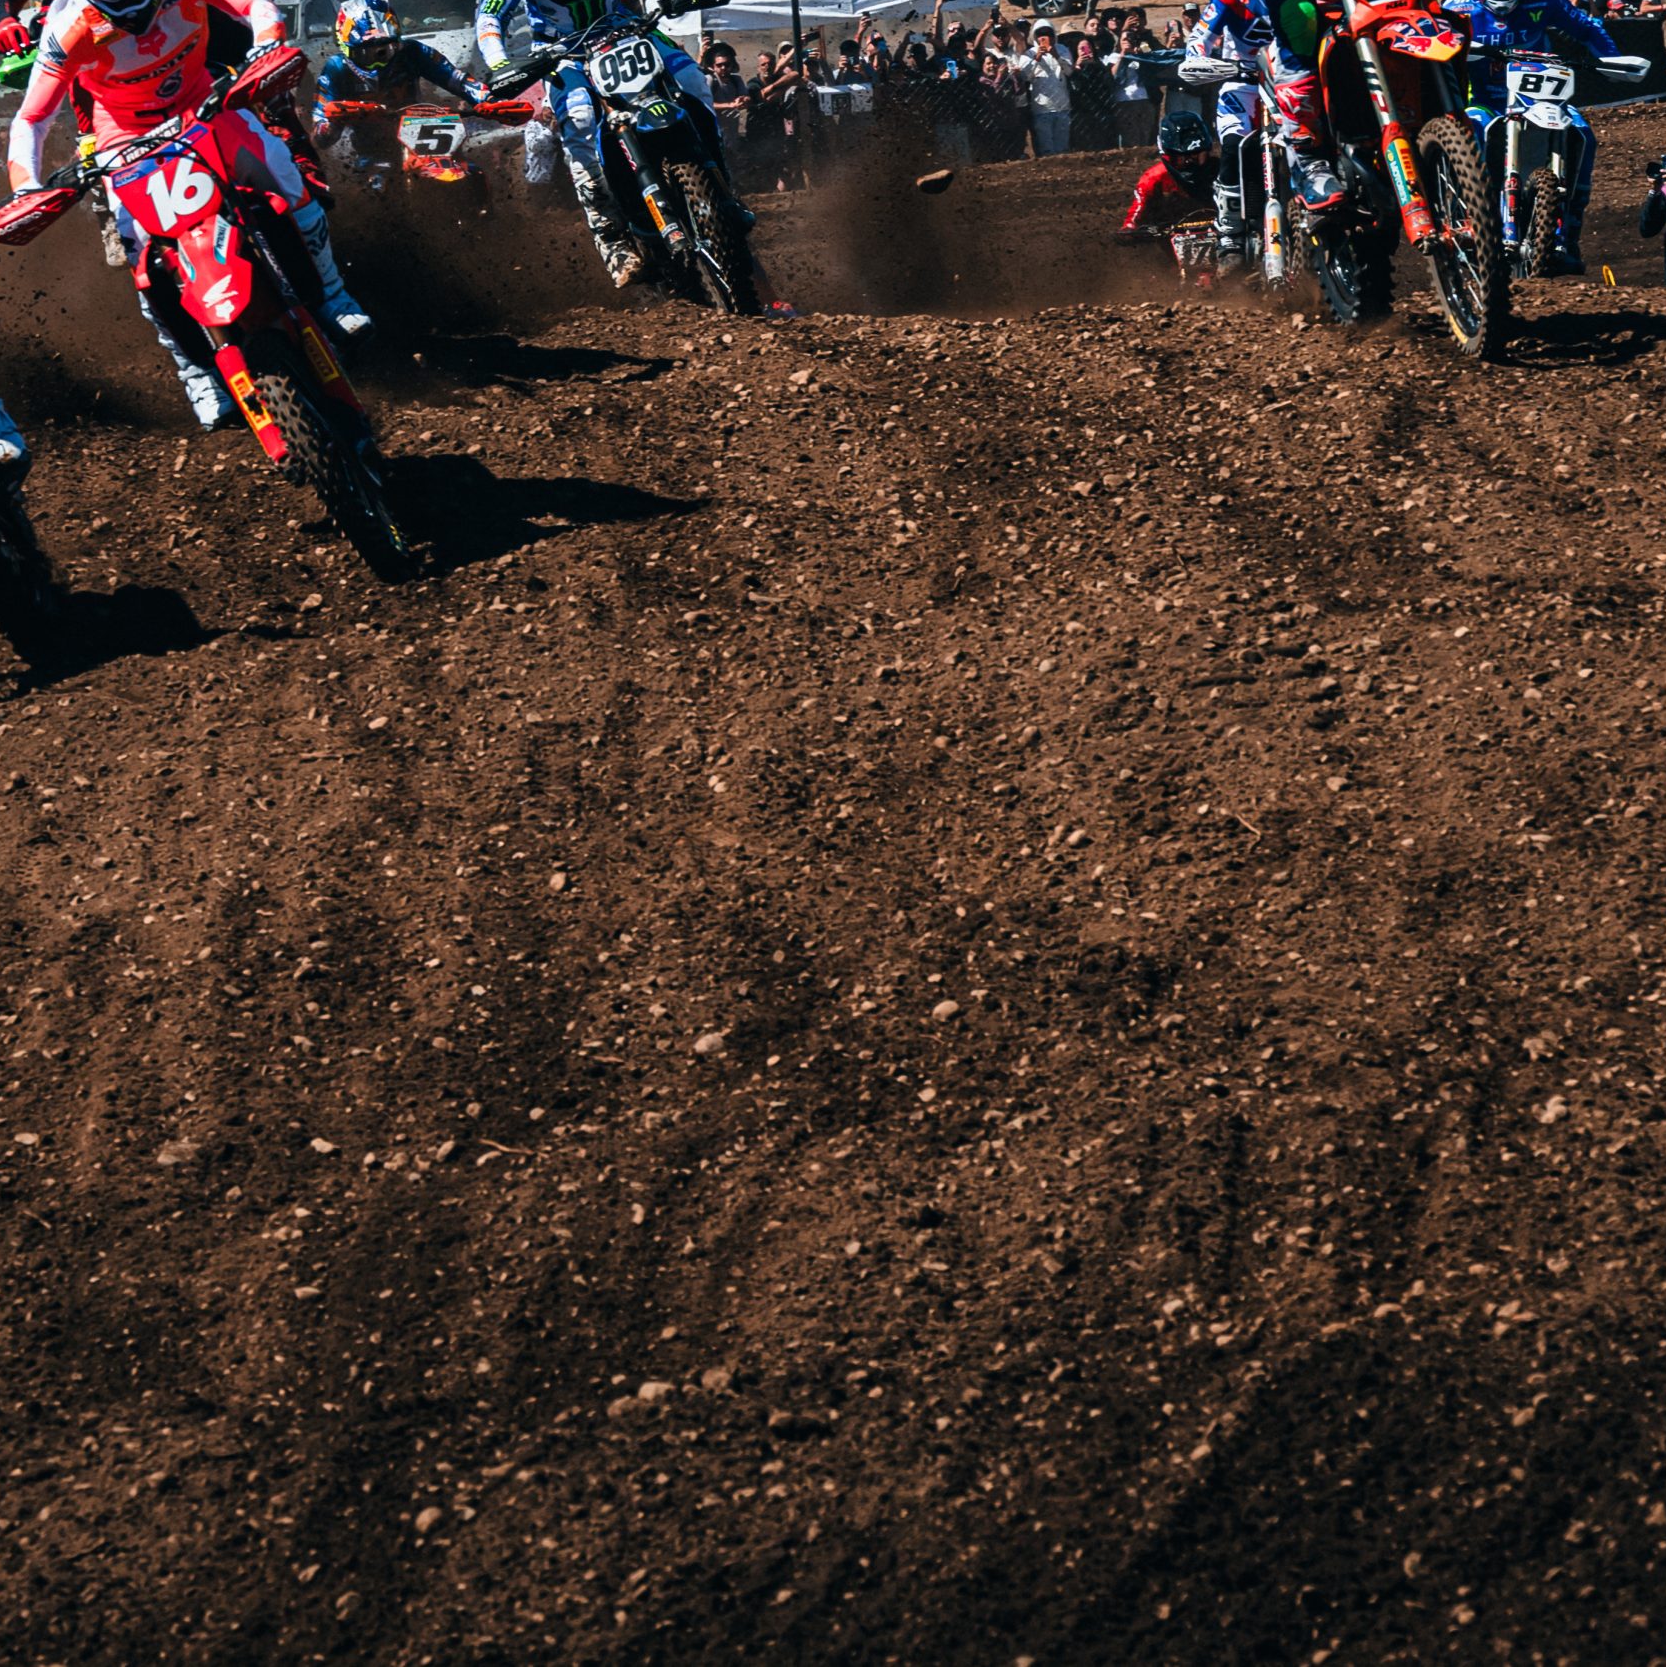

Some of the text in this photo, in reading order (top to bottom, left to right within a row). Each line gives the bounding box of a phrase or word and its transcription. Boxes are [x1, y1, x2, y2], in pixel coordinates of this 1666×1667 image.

[491, 72, 528, 92] ACERBIS
[598, 40, 656, 93] 959
[1519, 73, 1568, 96] 87
[415, 124, 456, 156] 5
[145, 152, 215, 233] 16
